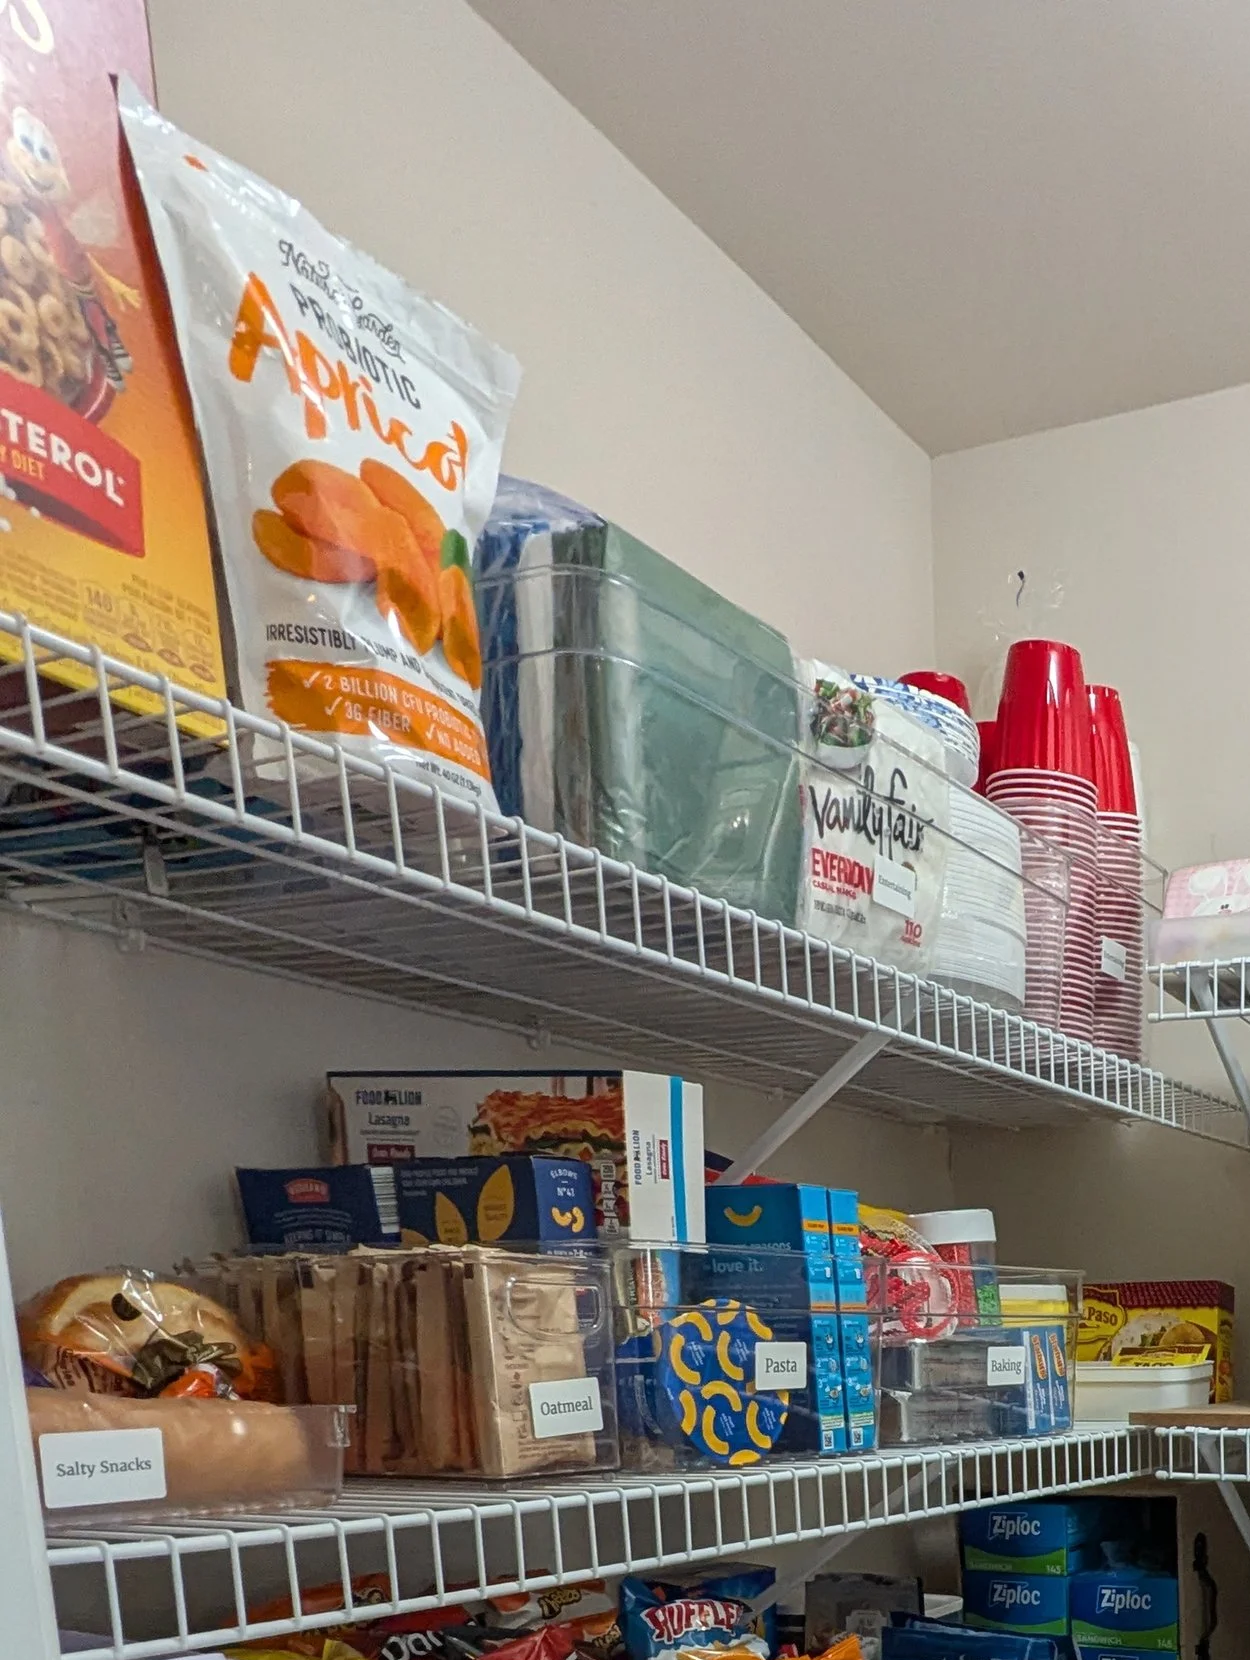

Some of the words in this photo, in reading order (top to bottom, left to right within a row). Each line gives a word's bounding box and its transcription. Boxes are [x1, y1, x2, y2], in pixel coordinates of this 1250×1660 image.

[290, 283, 421, 410] PROBIOTIC
[340, 678, 398, 704] BILLION
[904, 919, 923, 938] 110
[355, 1090, 382, 1106] FOOD
[398, 1090, 422, 1106] LION
[368, 1112, 410, 1128] Lasagna
[632, 1129, 640, 1150] LION
[645, 1141, 653, 1176] Lasagna
[634, 1163, 642, 1186] FOOD
[712, 1258, 744, 1273] love
[1088, 1307, 1118, 1327] Paso
[765, 1358, 797, 1373] Pasta
[991, 1358, 1022, 1375] Baking
[539, 1396, 594, 1416] Oatmeal
[56, 1462, 96, 1480] Salty
[100, 1457, 152, 1475] Snacks
[991, 1515, 1041, 1541] Ziploc
[992, 1583, 1041, 1610] Ziploc
[1100, 1588, 1152, 1615] Ziploc
